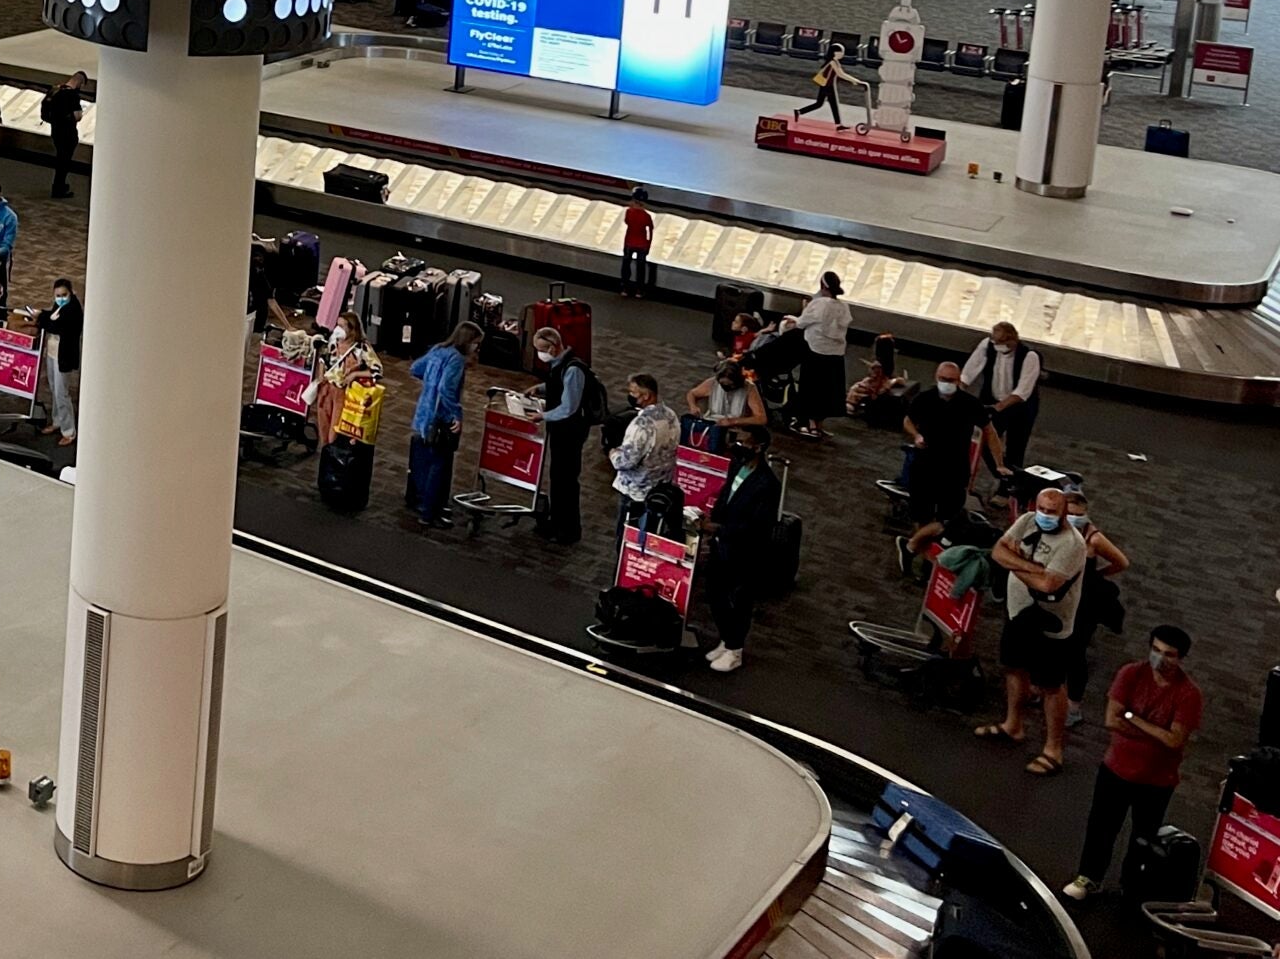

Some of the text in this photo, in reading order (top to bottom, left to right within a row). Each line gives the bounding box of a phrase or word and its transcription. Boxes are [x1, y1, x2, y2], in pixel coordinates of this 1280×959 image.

[471, 7, 519, 25] testing.
[470, 29, 515, 43] FlyClear
[760, 119, 785, 132] CIBC
